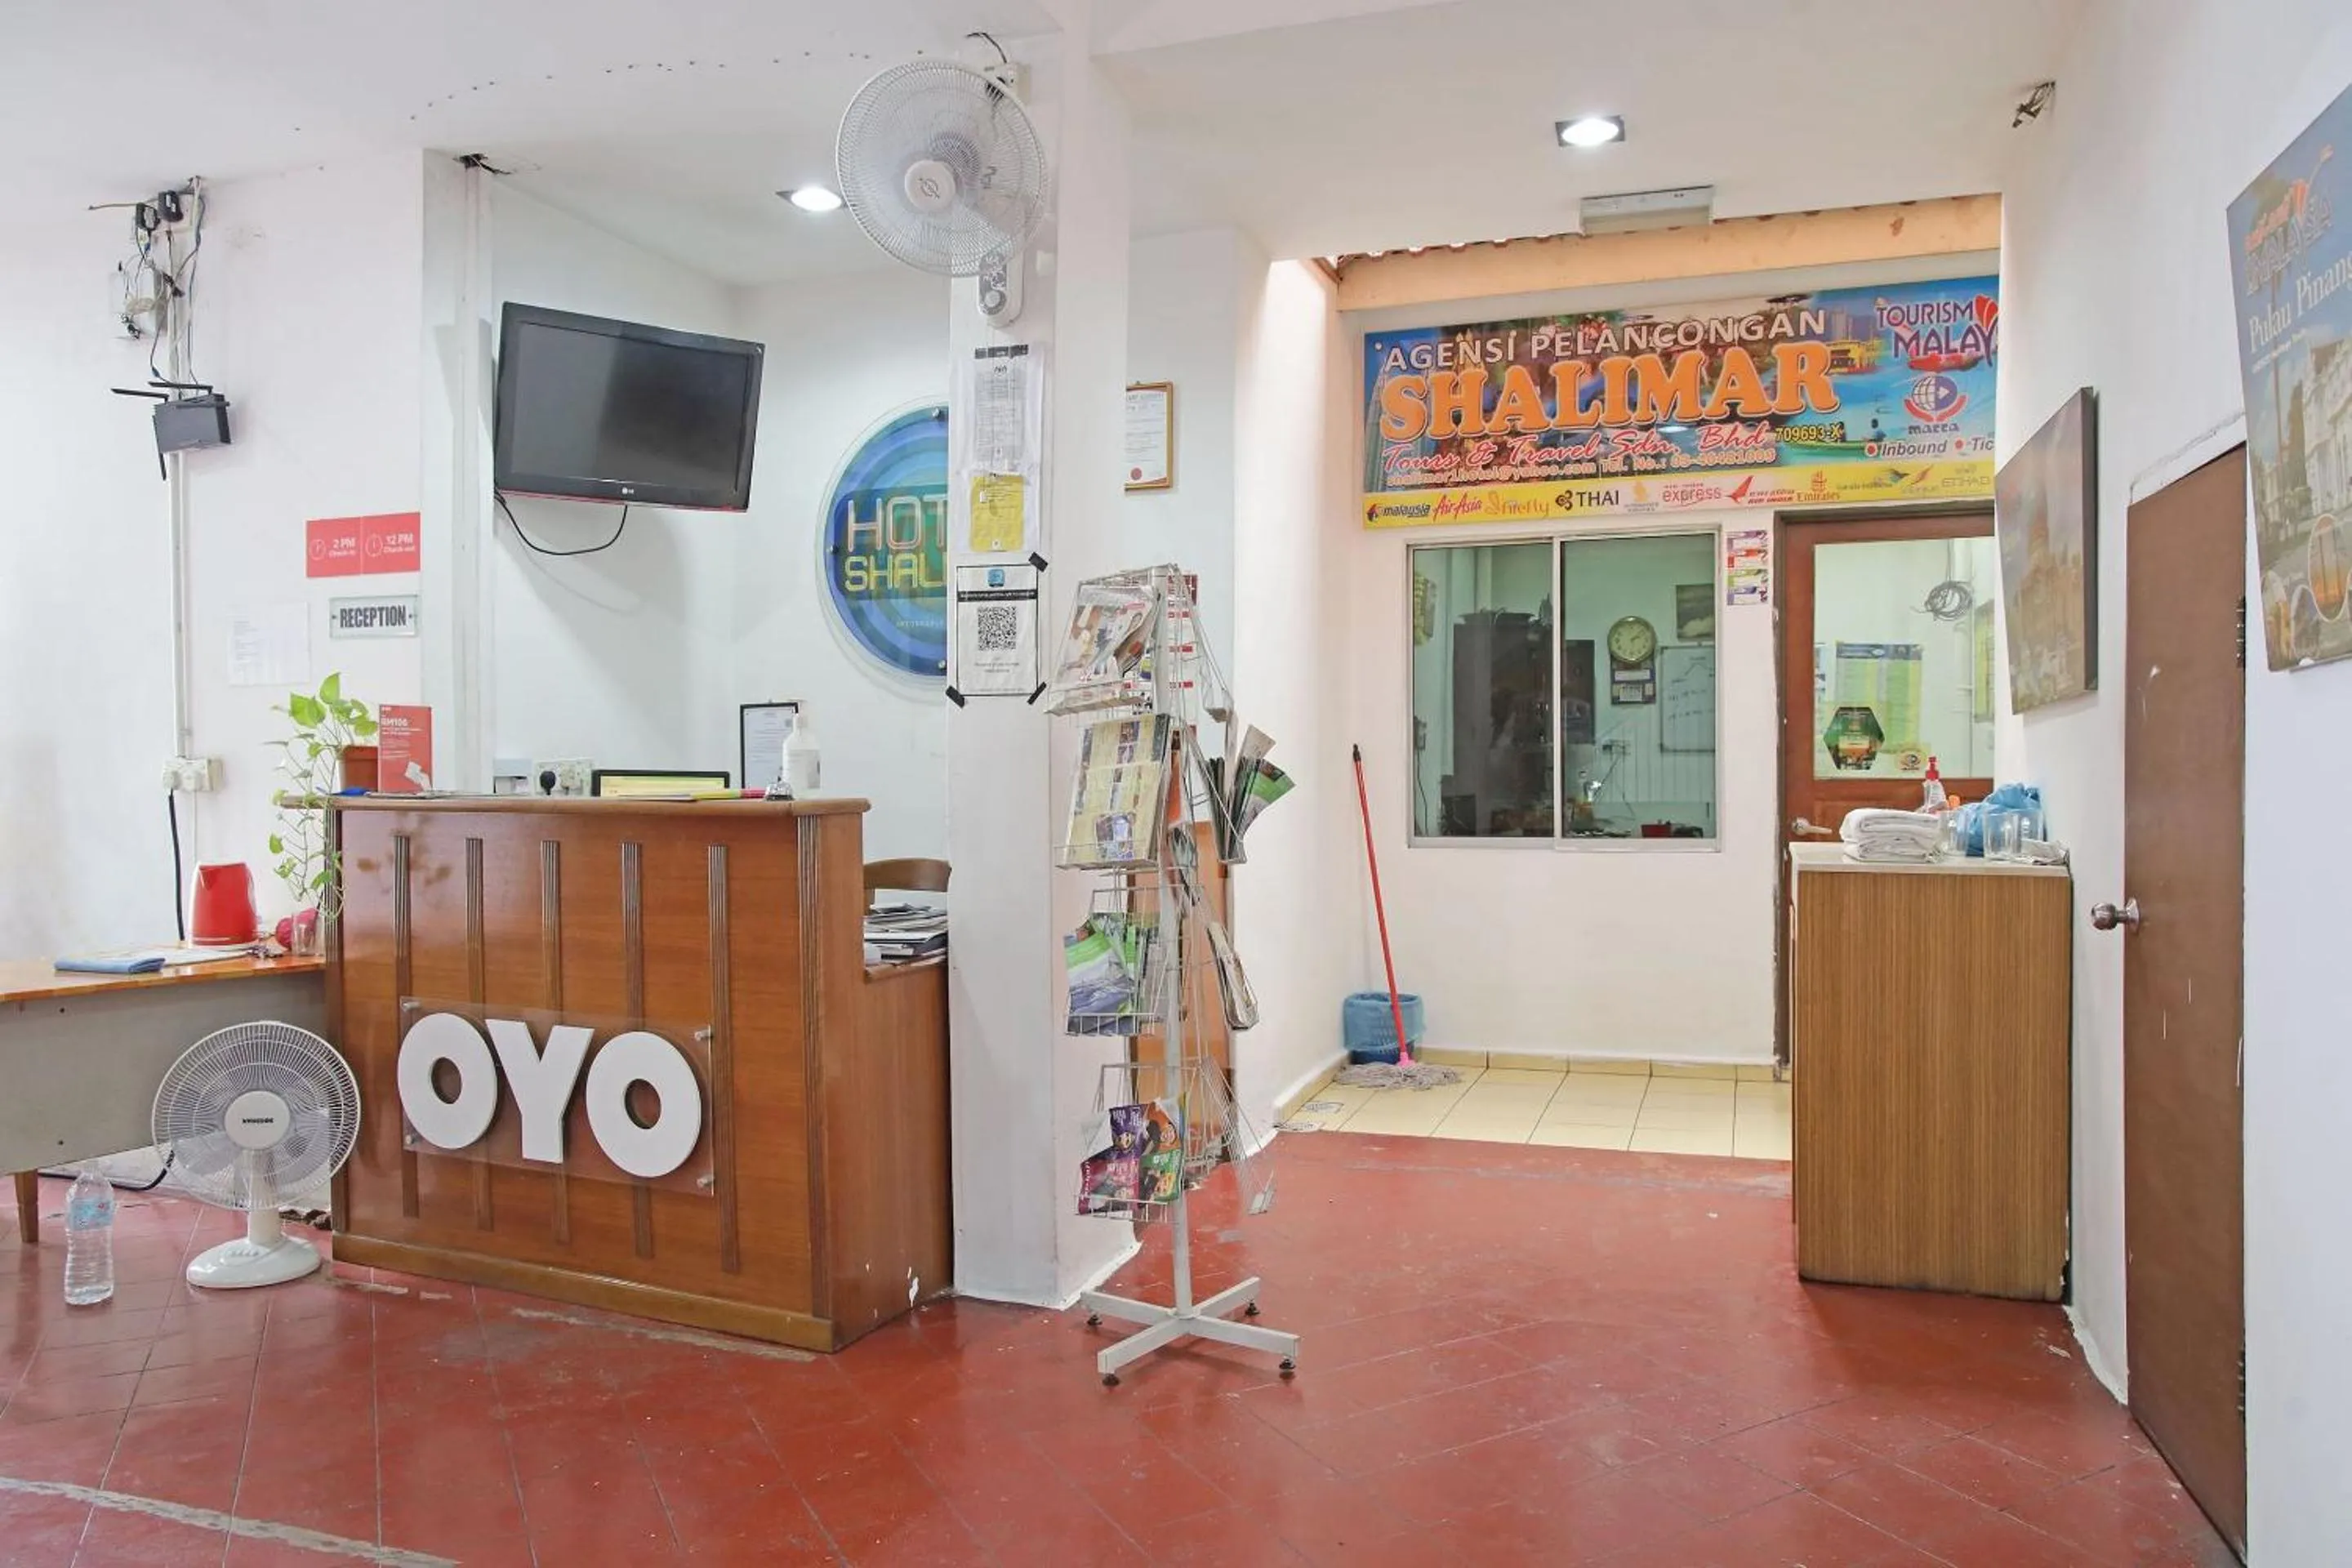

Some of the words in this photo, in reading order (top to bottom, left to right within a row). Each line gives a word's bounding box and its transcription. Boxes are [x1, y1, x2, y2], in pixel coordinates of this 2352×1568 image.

[1877, 301, 1974, 328] TOURISM
[2249, 301, 2292, 354] Pulau
[1384, 336, 1517, 372] AGENSI
[1531, 310, 1826, 359] PELANCONGAN
[1894, 317, 1998, 367] MALAY
[1380, 341, 1841, 442] SHALIMAR
[1382, 443, 1460, 471] Tours
[1466, 441, 1498, 466] &
[1507, 433, 1601, 465] Travel
[1610, 428, 1681, 458] Sdn.
[1697, 420, 1771, 451] Bhd
[1882, 440, 1948, 457] Inbound
[1576, 490, 1619, 507] THAI
[1663, 488, 1722, 504] express
[332, 539, 340, 549] 2
[340, 537, 356, 550] PM
[386, 534, 396, 545] 12
[397, 532, 413, 545] PM
[340, 606, 407, 628] RECEPTION
[397, 1013, 702, 1178] OYO
